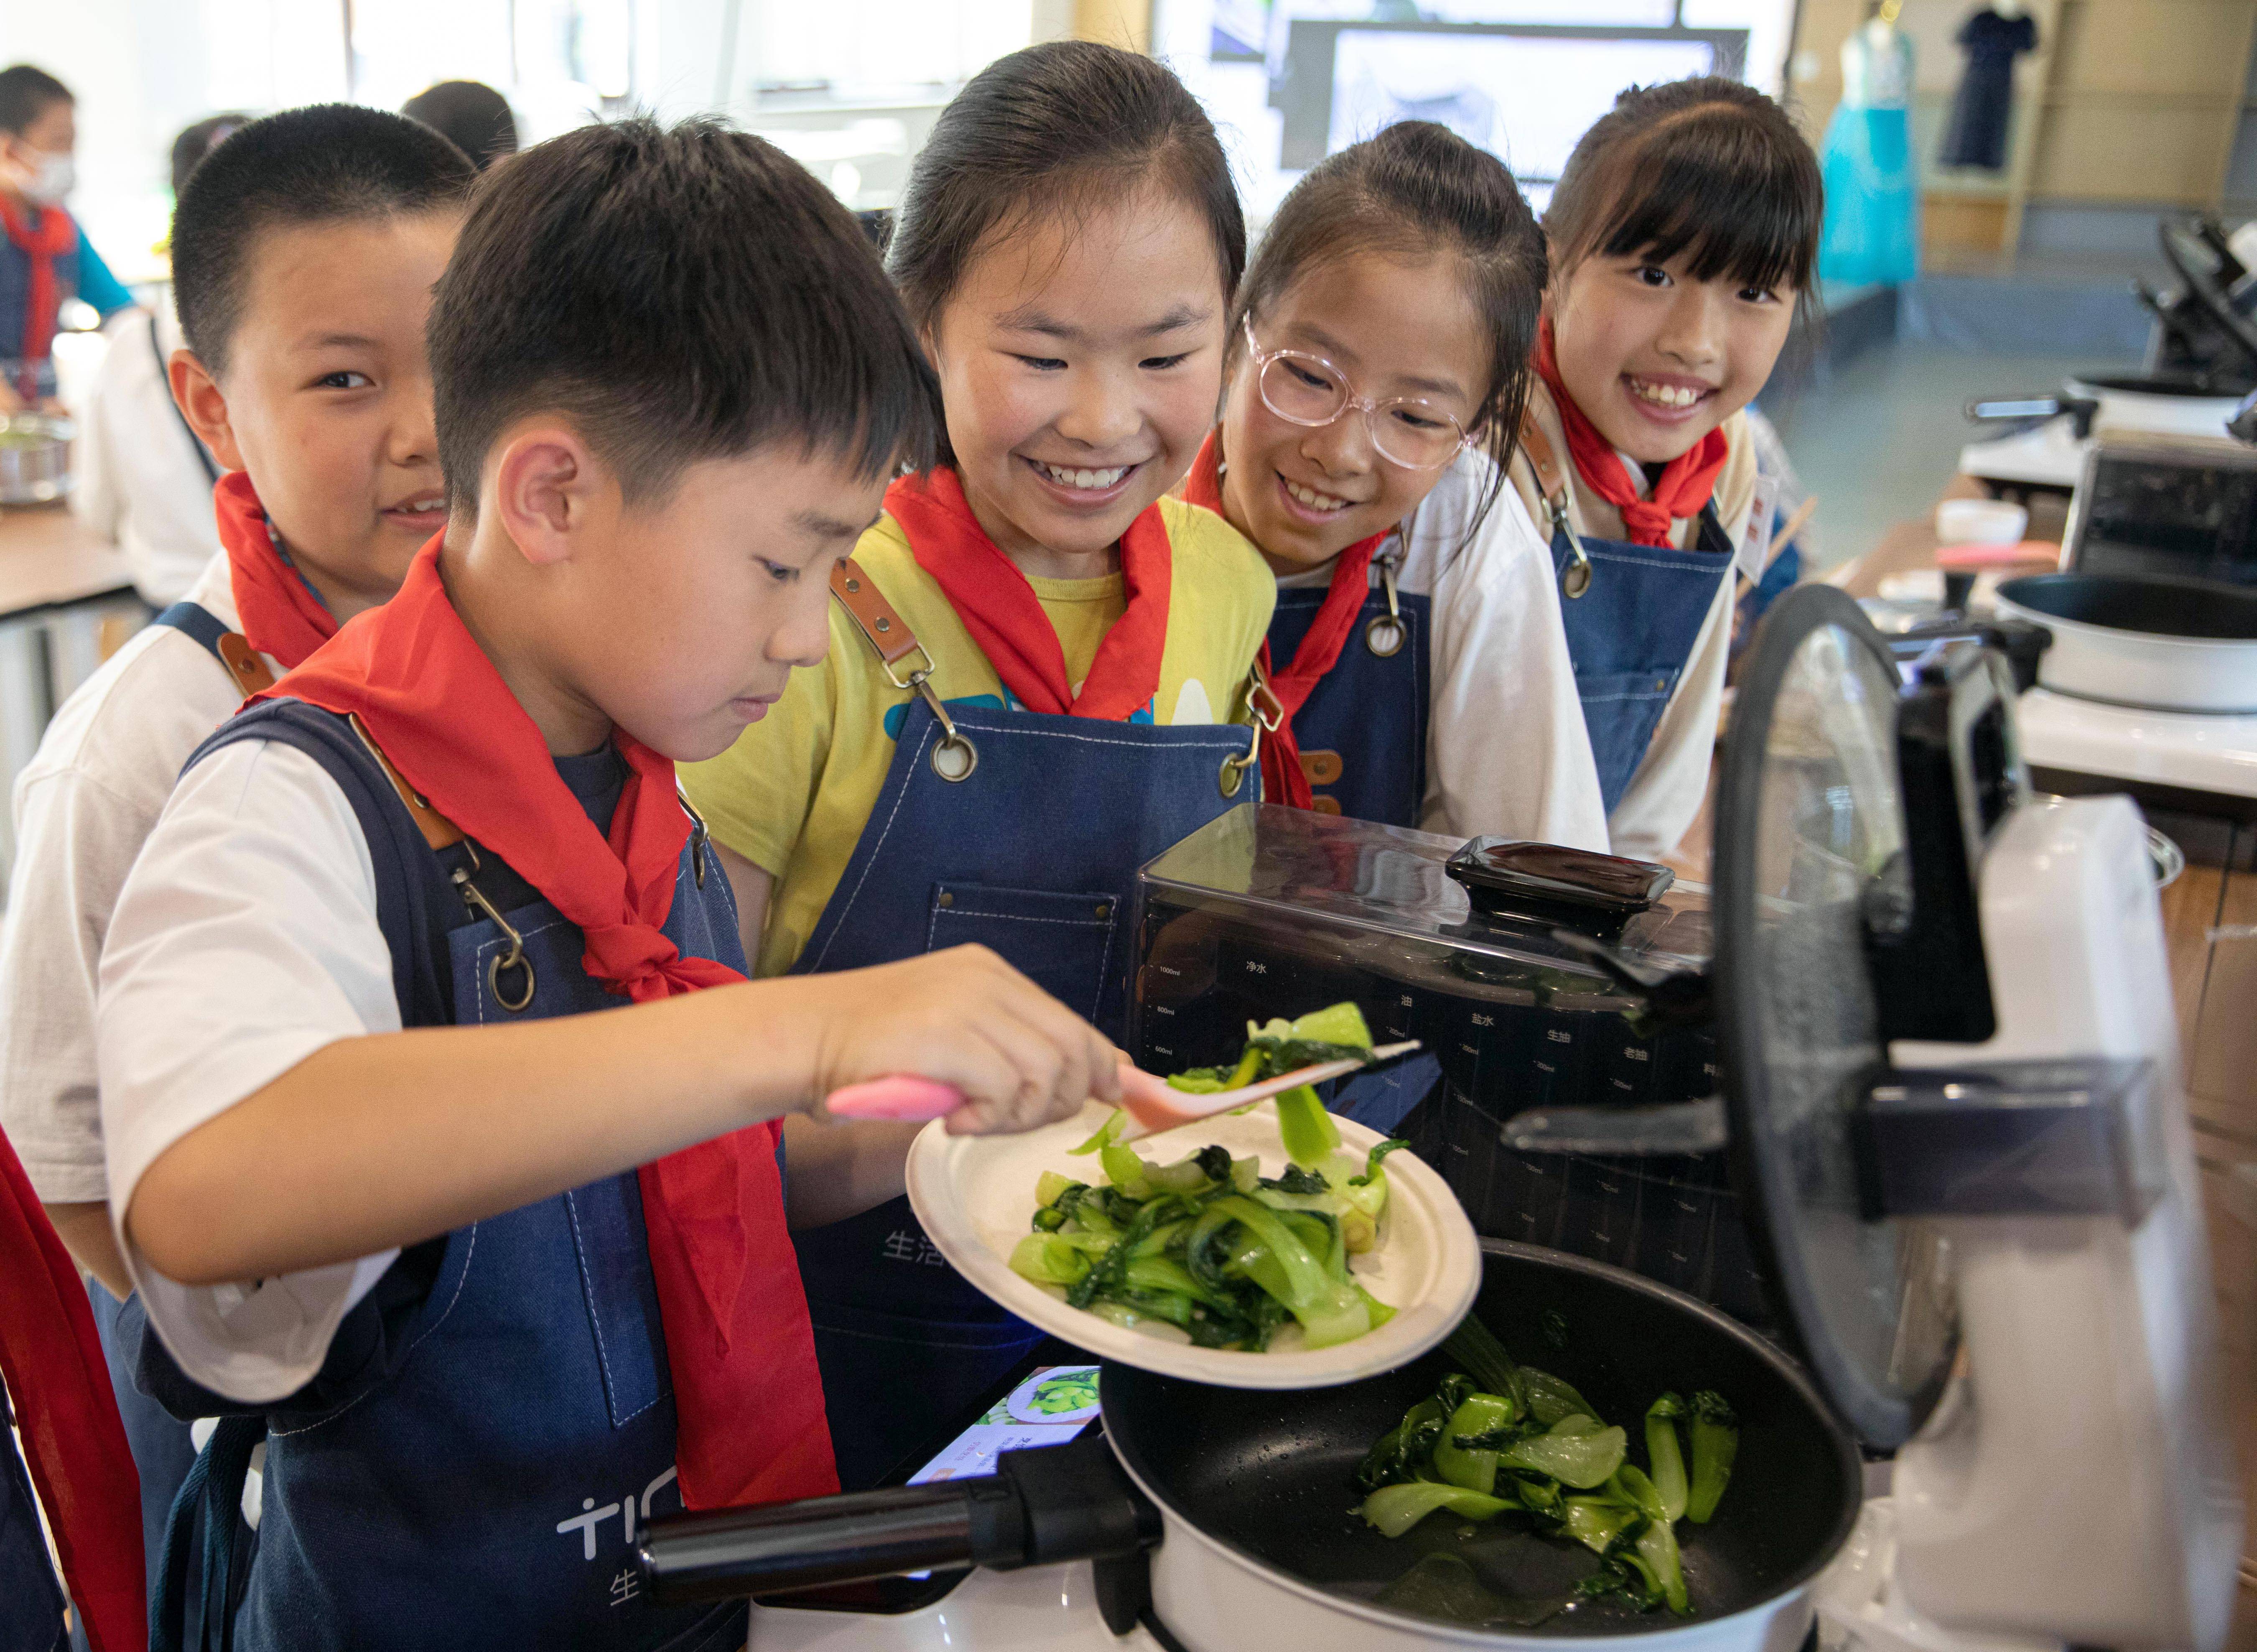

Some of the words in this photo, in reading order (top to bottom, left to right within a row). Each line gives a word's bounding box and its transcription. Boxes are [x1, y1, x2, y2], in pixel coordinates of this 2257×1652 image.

[1160, 966, 1180, 976] 1000ml
[1246, 961, 1266, 973] 净水
[1401, 995, 1412, 1007] 油
[1157, 1006, 1174, 1015] 800ml
[1471, 1012, 1495, 1026] 盐水
[1389, 1027, 1405, 1038] 200ml
[1547, 1030, 1571, 1043] 生抽
[1155, 1045, 1172, 1055] 600ml
[1462, 1044, 1479, 1055] 200ml
[1623, 1047, 1648, 1061] 老抽
[1537, 1061, 1555, 1072] 200ml
[1384, 1078, 1400, 1088] 150ml
[1457, 1095, 1473, 1106] 150ml
[1452, 1145, 1468, 1156] 100ml
[882, 1231, 944, 1266] 生活
